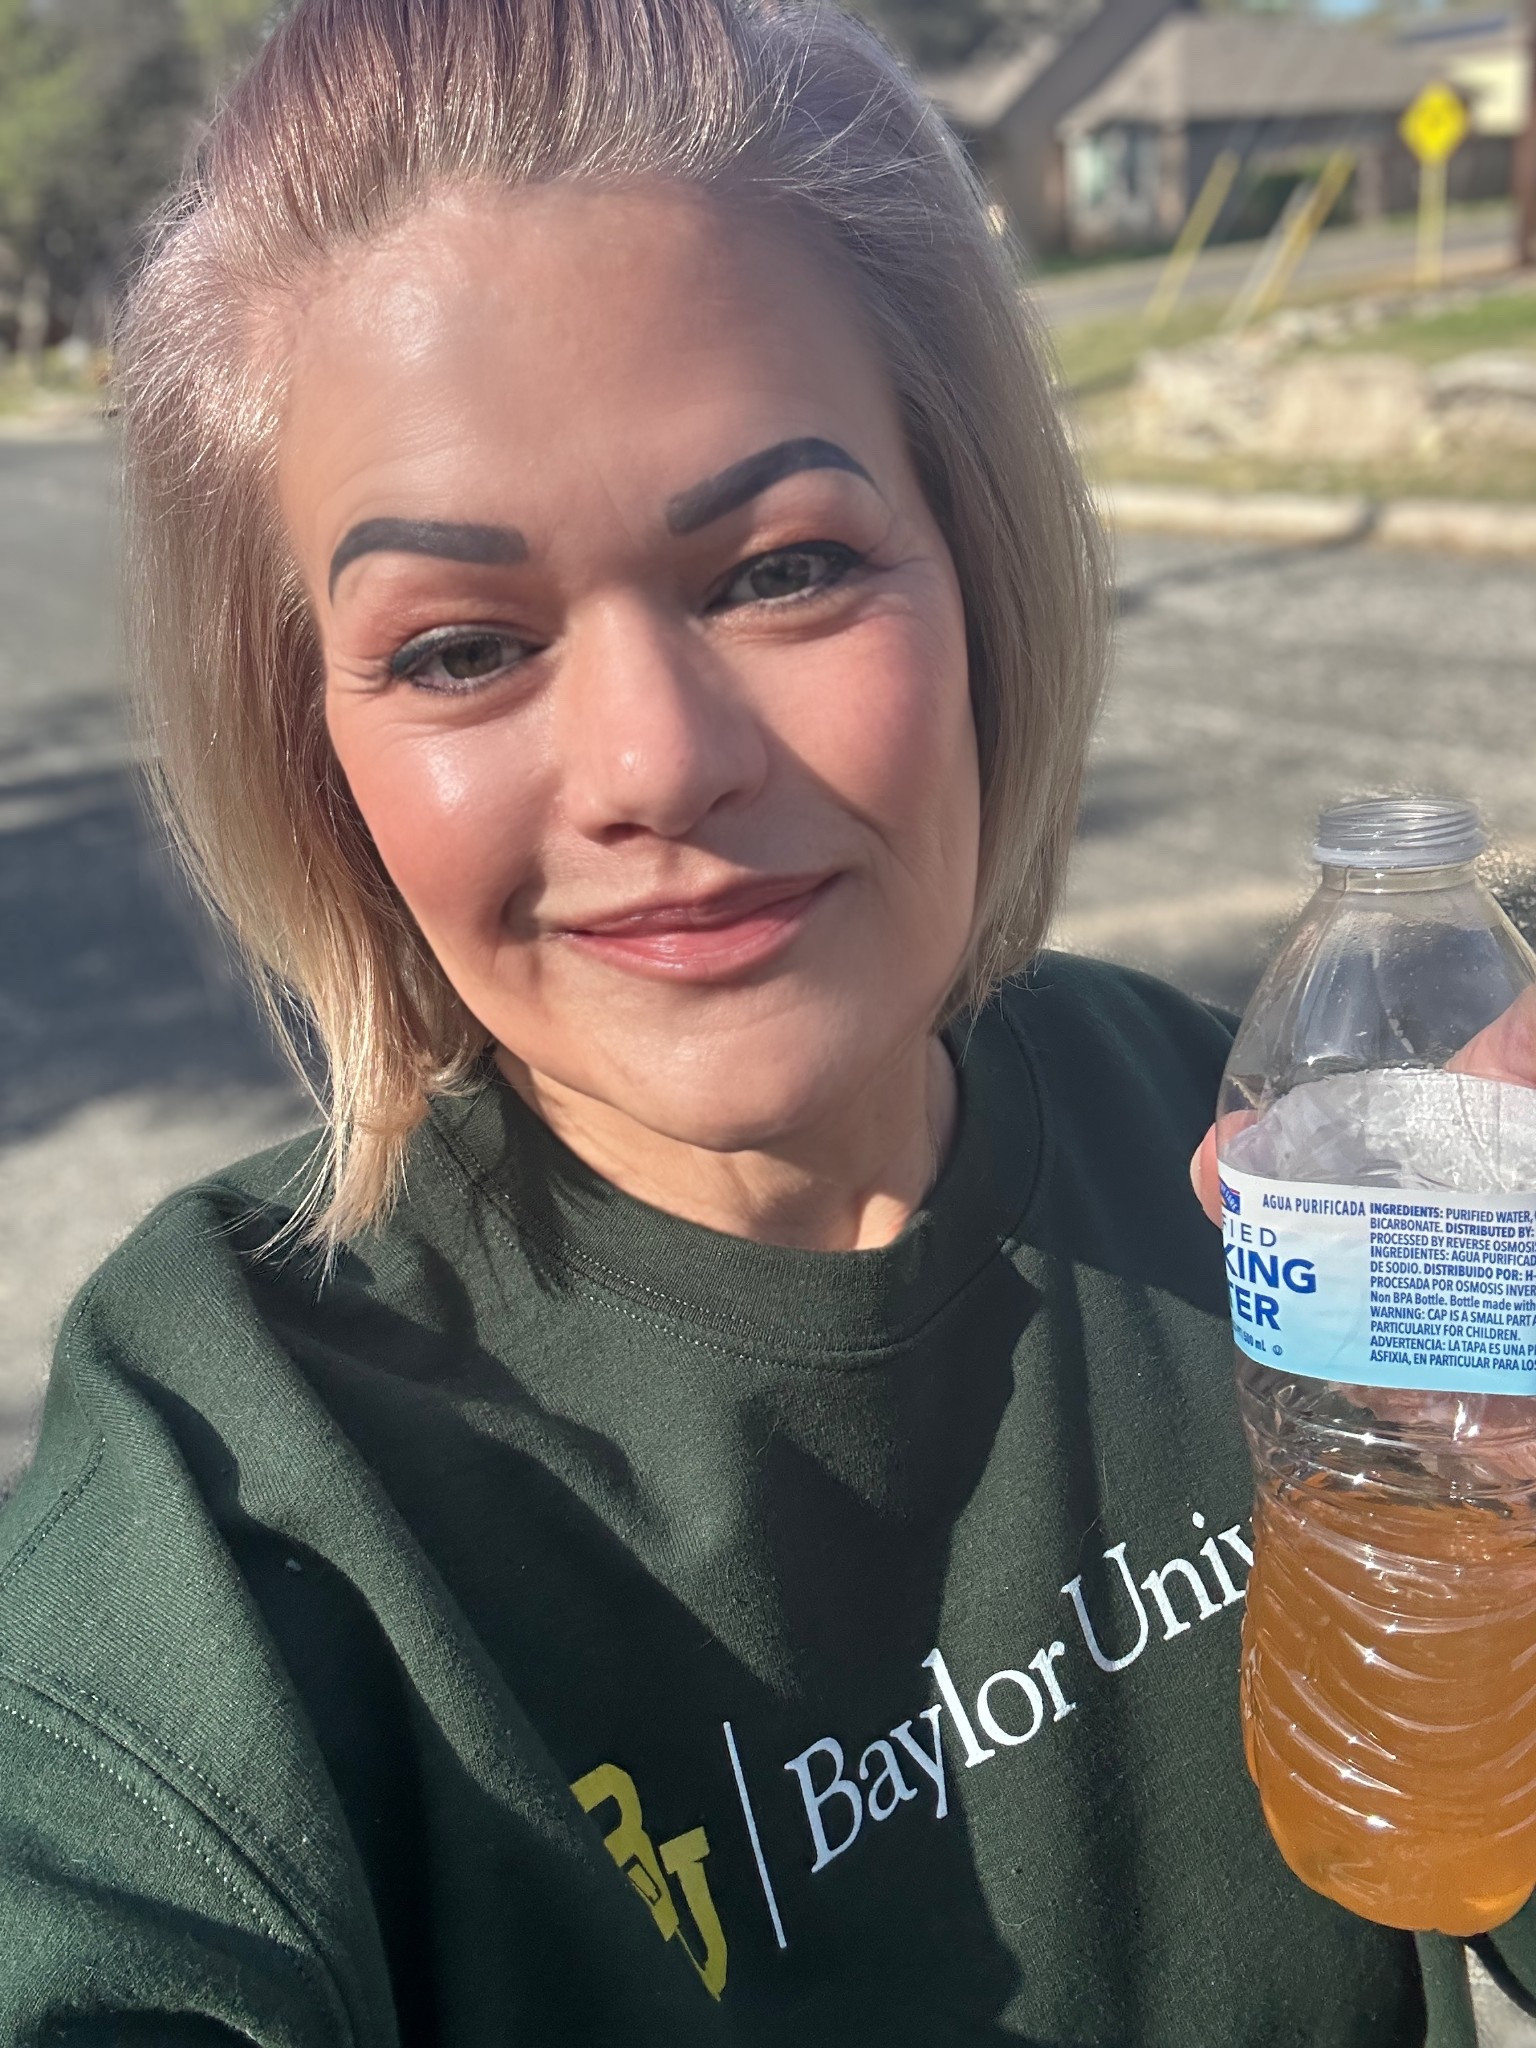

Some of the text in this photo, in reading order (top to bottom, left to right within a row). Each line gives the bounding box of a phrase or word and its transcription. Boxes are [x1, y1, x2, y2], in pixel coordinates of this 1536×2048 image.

[1263, 1194, 1366, 1216] AGUA PURIFICADA
[1370, 1203, 1443, 1218] INGREDIENTS:
[1446, 1208, 1494, 1223] PURIFIED
[1496, 1211, 1533, 1223] WATER,
[1370, 1217, 1534, 1238] BICARBONATE. DISTRIBUTED BY:
[1370, 1232, 1429, 1246] PROCESSED
[1431, 1236, 1444, 1247] BY
[1446, 1237, 1491, 1251] REVERSE
[1370, 1246, 1450, 1261] INGREDIENTES:
[1451, 1250, 1480, 1262] AGUA
[1370, 1261, 1383, 1273] DE
[1386, 1262, 1421, 1274] SODIO.
[1424, 1263, 1494, 1279] DISTRIBUIDO
[1496, 1268, 1522, 1281] POR:
[1370, 1276, 1430, 1290] PROCESADA
[1432, 1279, 1453, 1291] POR
[1456, 1280, 1504, 1295] OSMOSIS
[1230, 1282, 1281, 1331] ER
[1370, 1291, 1536, 1311] Non BPA Bottle. Bottle made with
[1370, 1306, 1425, 1320] WARNING:
[1427, 1309, 1447, 1321] CAP
[1450, 1310, 1459, 1321] IS
[1461, 1311, 1468, 1322] A
[1470, 1312, 1504, 1325] SMALL
[1506, 1314, 1531, 1326] PART
[1370, 1321, 1521, 1341] PARTICULARLY FOR CHILDREN.
[1370, 1336, 1446, 1350] ADVERTENCIA:
[1448, 1340, 1460, 1351] LA
[1462, 1341, 1487, 1353] TAPA
[1489, 1343, 1500, 1354] ES
[1503, 1344, 1525, 1356] UNA
[1370, 1350, 1411, 1365] ASFIXIA,
[1414, 1353, 1427, 1365] EN
[1430, 1354, 1490, 1369] PARTICULAR
[1493, 1358, 1519, 1371] PARA
[784, 1641, 1077, 1873] Baylor
